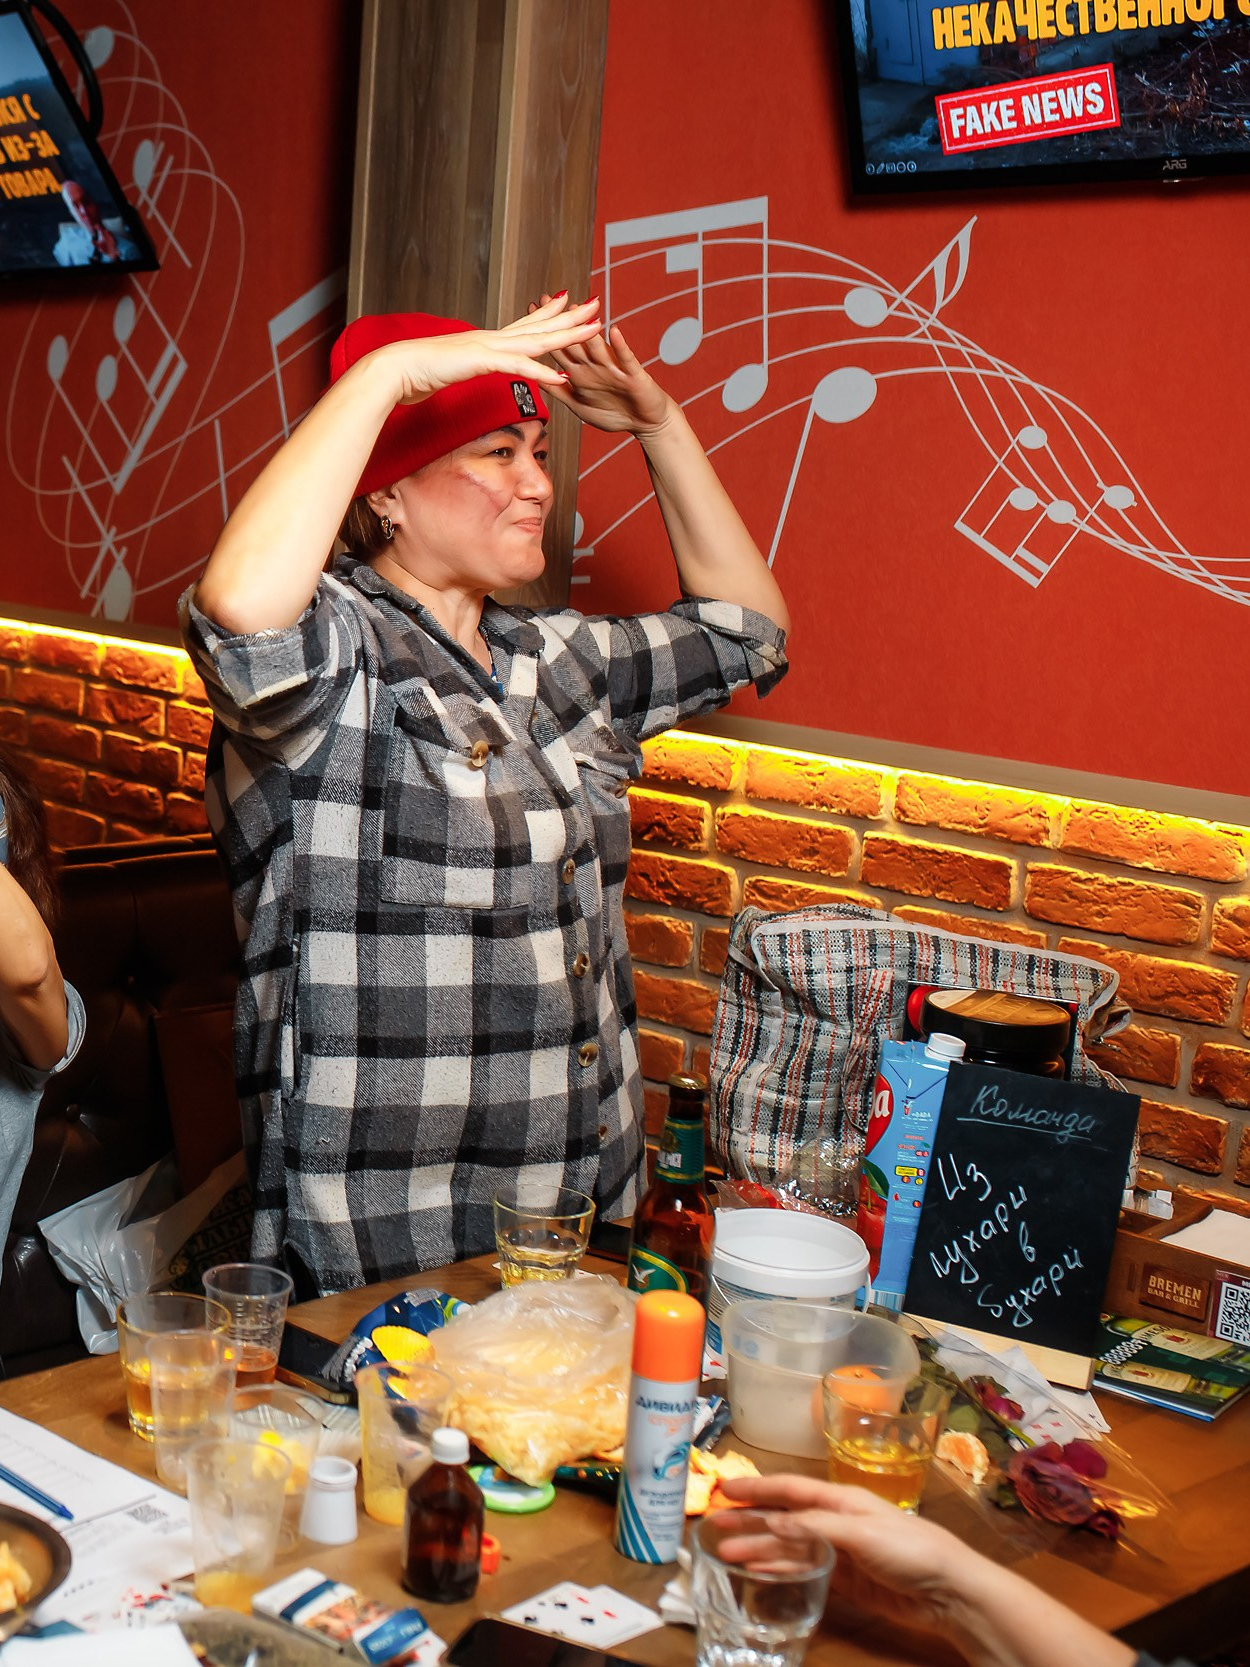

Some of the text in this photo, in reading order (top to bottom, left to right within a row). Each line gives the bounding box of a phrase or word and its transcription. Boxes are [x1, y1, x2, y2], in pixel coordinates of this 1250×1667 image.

[22, 93, 41, 120] С
[949, 81, 1105, 139] FAKE NEWS
[0, 129, 60, 162] ИЗ-ЗА
[1162, 159, 1187, 171] ARG
[970, 1085, 1096, 1144] Команда
[937, 1153, 992, 1201] Из
[1147, 1287, 1165, 1299] BAR
[1173, 1295, 1201, 1309] GRILL
[1149, 1275, 1202, 1301] BREMEN
